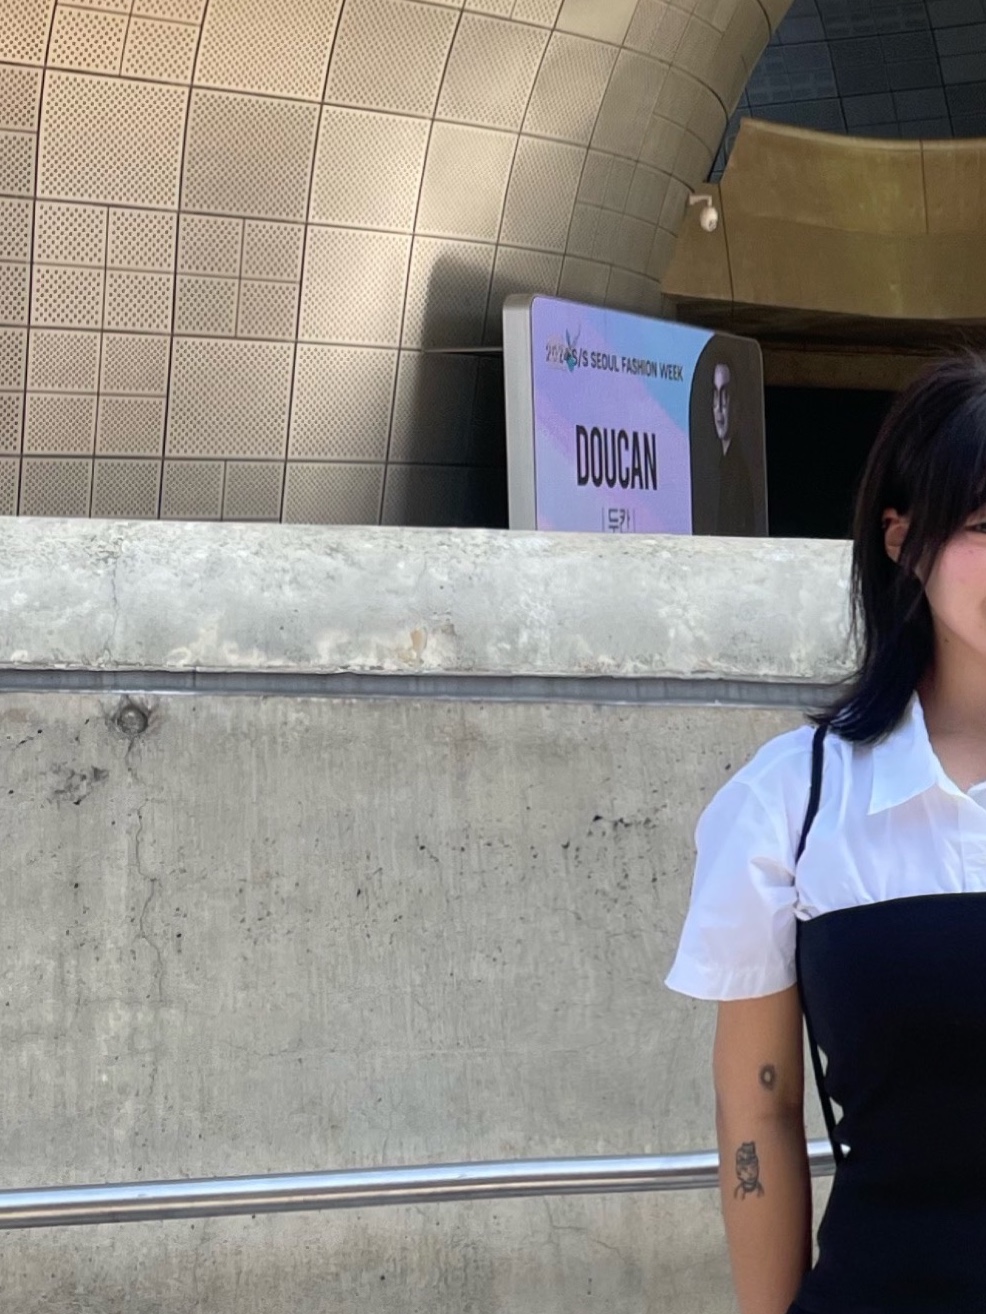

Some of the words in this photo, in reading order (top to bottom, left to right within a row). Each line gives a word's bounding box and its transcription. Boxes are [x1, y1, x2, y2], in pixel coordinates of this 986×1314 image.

[590, 351, 619, 373] SEOUL
[621, 356, 657, 378] FASHION
[659, 362, 684, 382] WEEK
[576, 424, 658, 491] DOUCAN
[608, 508, 630, 533] 두칸
